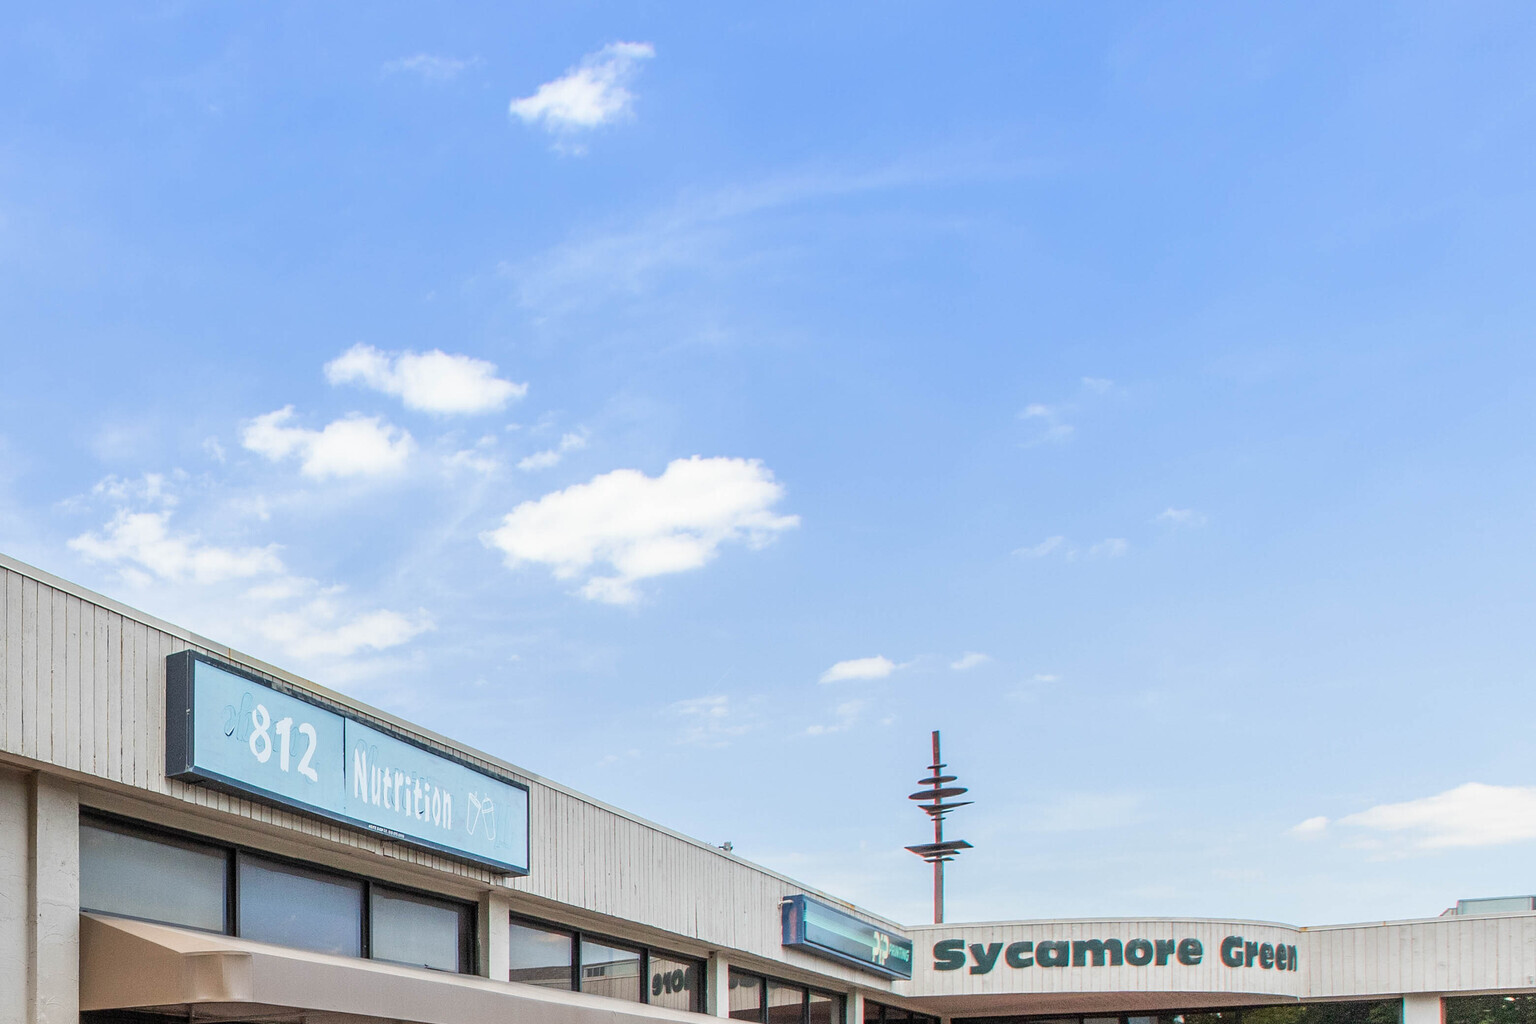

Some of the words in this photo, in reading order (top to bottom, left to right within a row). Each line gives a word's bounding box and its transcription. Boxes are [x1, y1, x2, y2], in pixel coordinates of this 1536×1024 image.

[249, 704, 319, 783] 812
[353, 748, 453, 830] Nutrition
[932, 937, 1204, 975] Sycamore
[1219, 935, 1298, 972] Green
